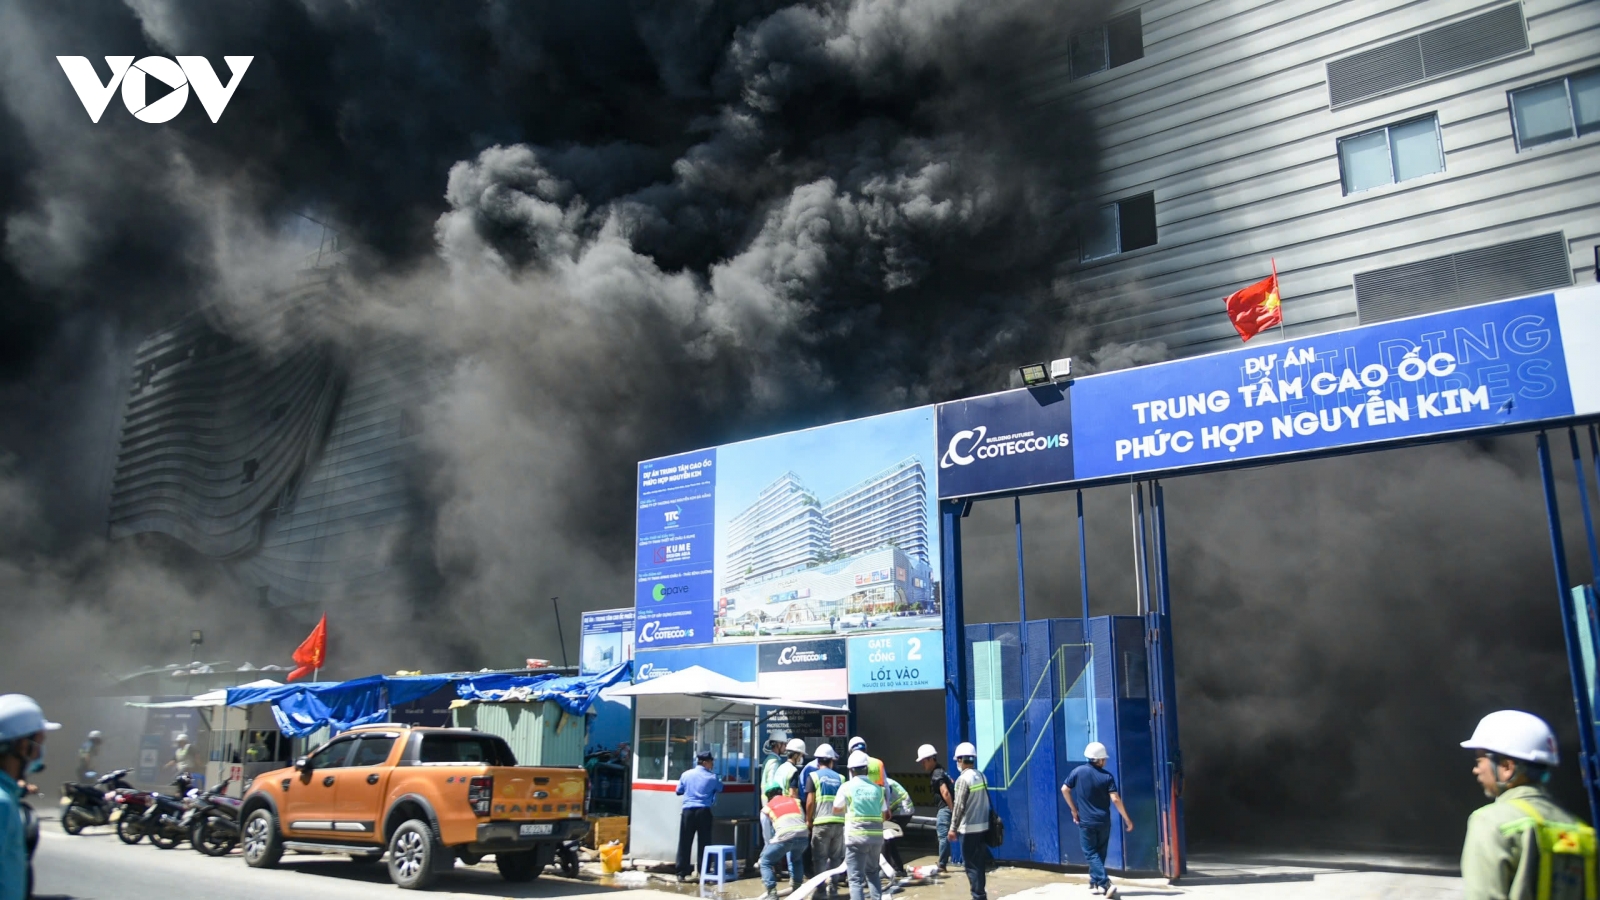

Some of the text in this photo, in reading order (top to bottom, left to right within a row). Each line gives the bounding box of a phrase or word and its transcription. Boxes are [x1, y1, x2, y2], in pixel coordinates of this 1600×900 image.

[1244, 346, 1316, 376] DỰ ÁN
[1132, 346, 1457, 424] TRUNG TÂM CAO ỐC
[1115, 385, 1490, 462] PHỨC HỢP NGUYỄN KIM
[986, 431, 1035, 443] BUILDING FUTURES
[977, 433, 1070, 459] COTECCONS
[660, 466, 678, 476] TRUNG
[678, 464, 690, 472] TÂM
[643, 478, 658, 487] PHỨC
[690, 470, 702, 478] KIM
[664, 510, 680, 522] TTC
[666, 542, 691, 554] KUME
[660, 585, 689, 596] apave
[654, 628, 694, 640] COTECCONS
[868, 638, 892, 649] GATE
[907, 636, 922, 661] 2
[871, 666, 920, 680] LỐI VÀO
[494, 804, 581, 813] RANGER
